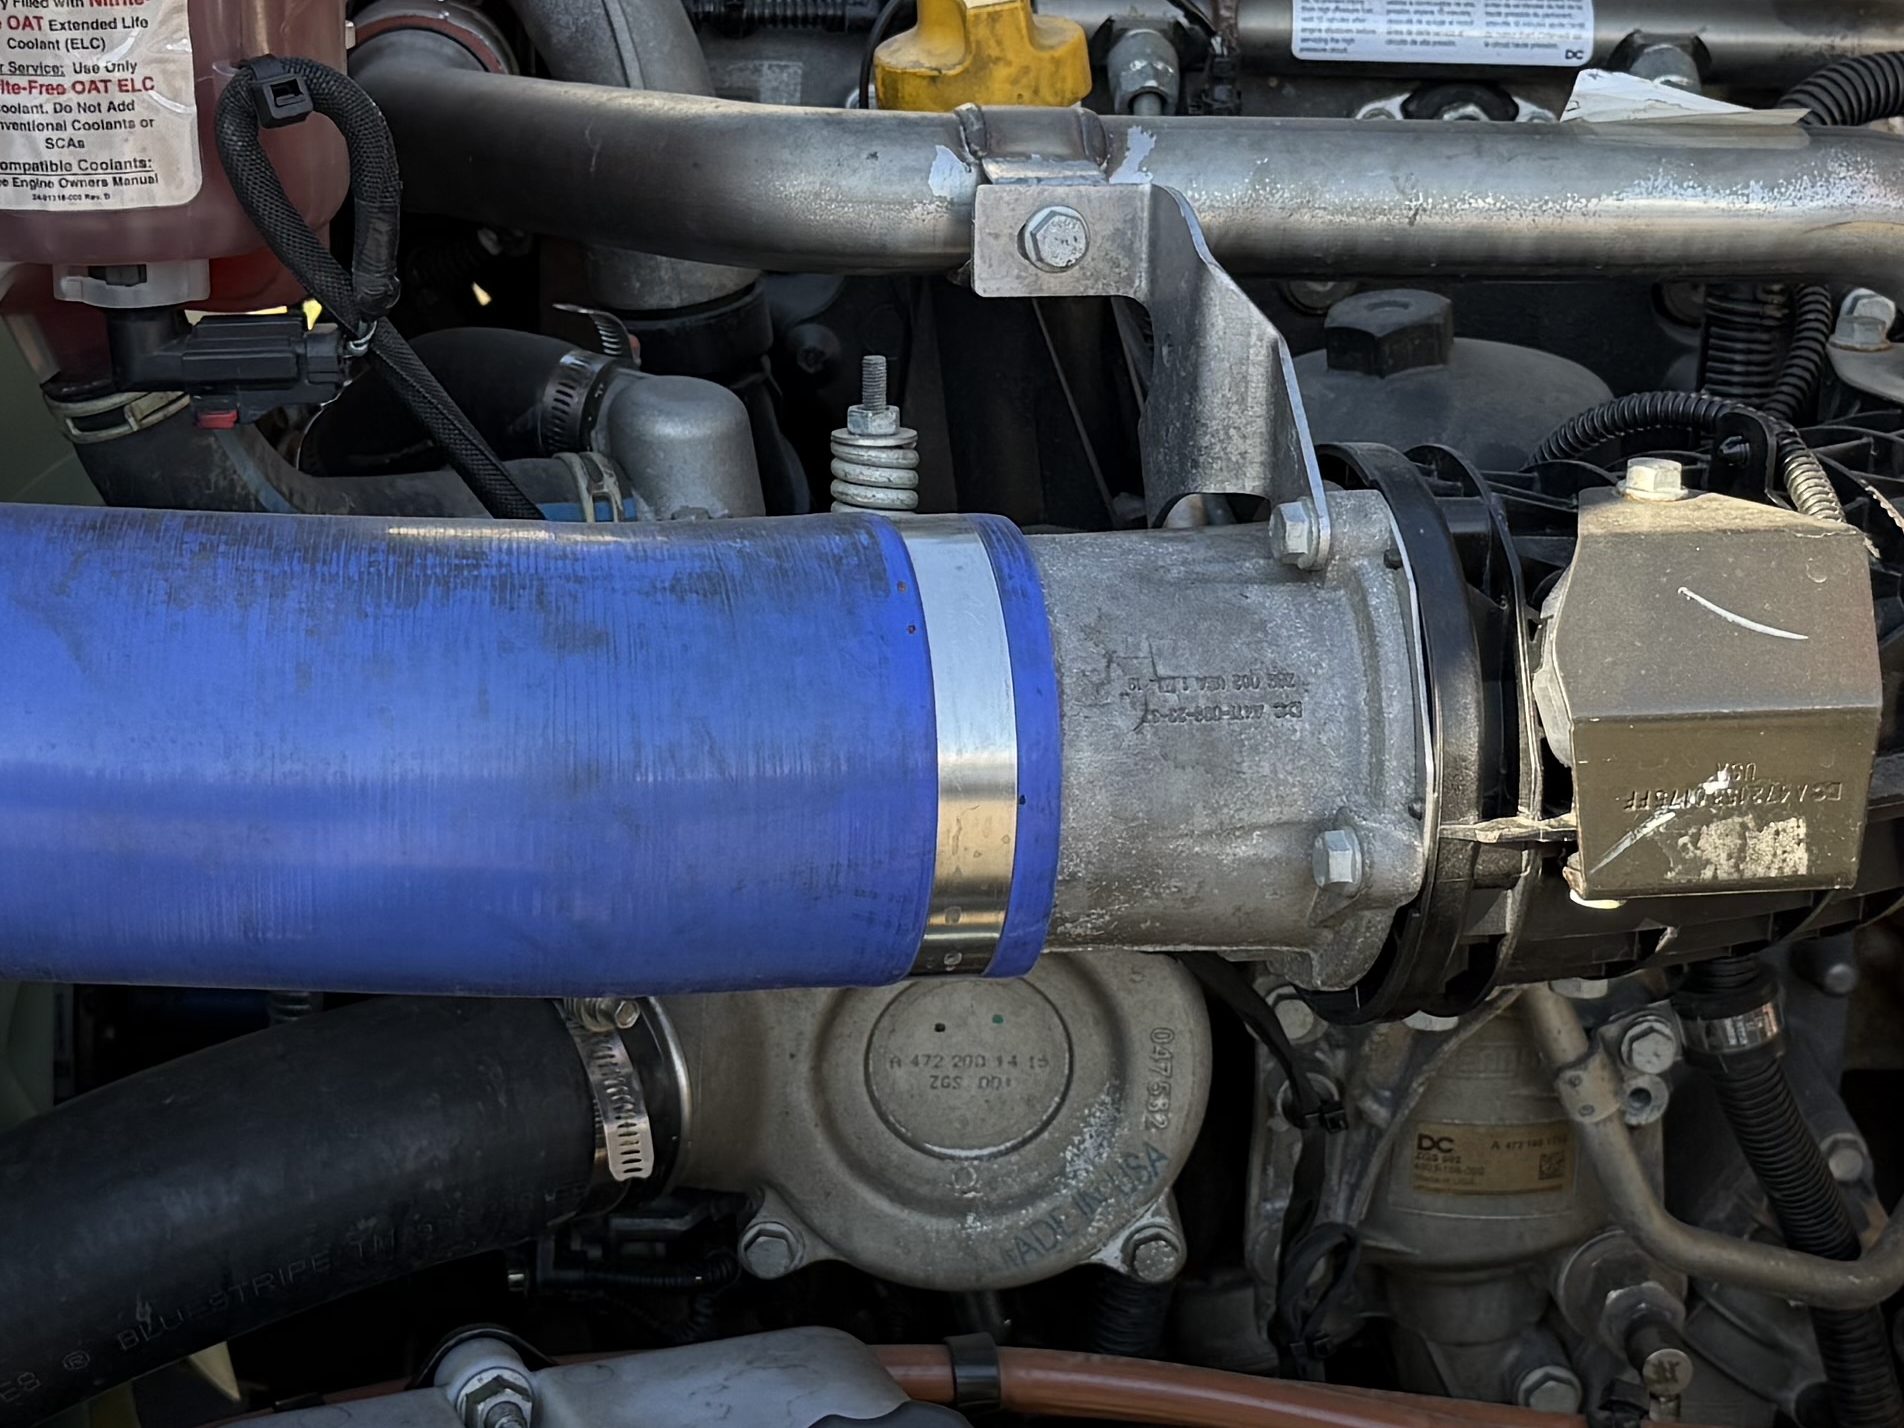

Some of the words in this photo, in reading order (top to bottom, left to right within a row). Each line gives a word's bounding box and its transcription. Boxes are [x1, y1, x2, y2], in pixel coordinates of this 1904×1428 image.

[7, 15, 44, 31] OAT
[49, 19, 118, 32] Extended
[121, 16, 149, 29] Life
[7, 38, 60, 51] Coolant
[65, 37, 106, 53] (ELC)
[1564, 50, 1584, 61] DC
[8, 61, 65, 76] Service:
[72, 63, 100, 74] Use
[105, 60, 137, 75] Only
[71, 79, 112, 94] OAT
[118, 76, 155, 92] ELC
[53, 102, 73, 114] Do
[77, 101, 102, 114] Not
[107, 100, 135, 112] Add
[71, 118, 136, 131] Coolants
[139, 119, 155, 129] or
[45, 138, 85, 150] SCAs
[77, 158, 153, 171] Coolants:
[12, 176, 55, 190] Engine
[58, 176, 108, 189] Owners
[112, 174, 159, 186] Manual
[889, 1055, 901, 1069] A
[910, 1054, 943, 1068] 472
[930, 1074, 961, 1089] ZGS
[1417, 1133, 1454, 1153] DC
[1074, 1185, 1104, 1219] IN
[1109, 1140, 1170, 1200] USA
